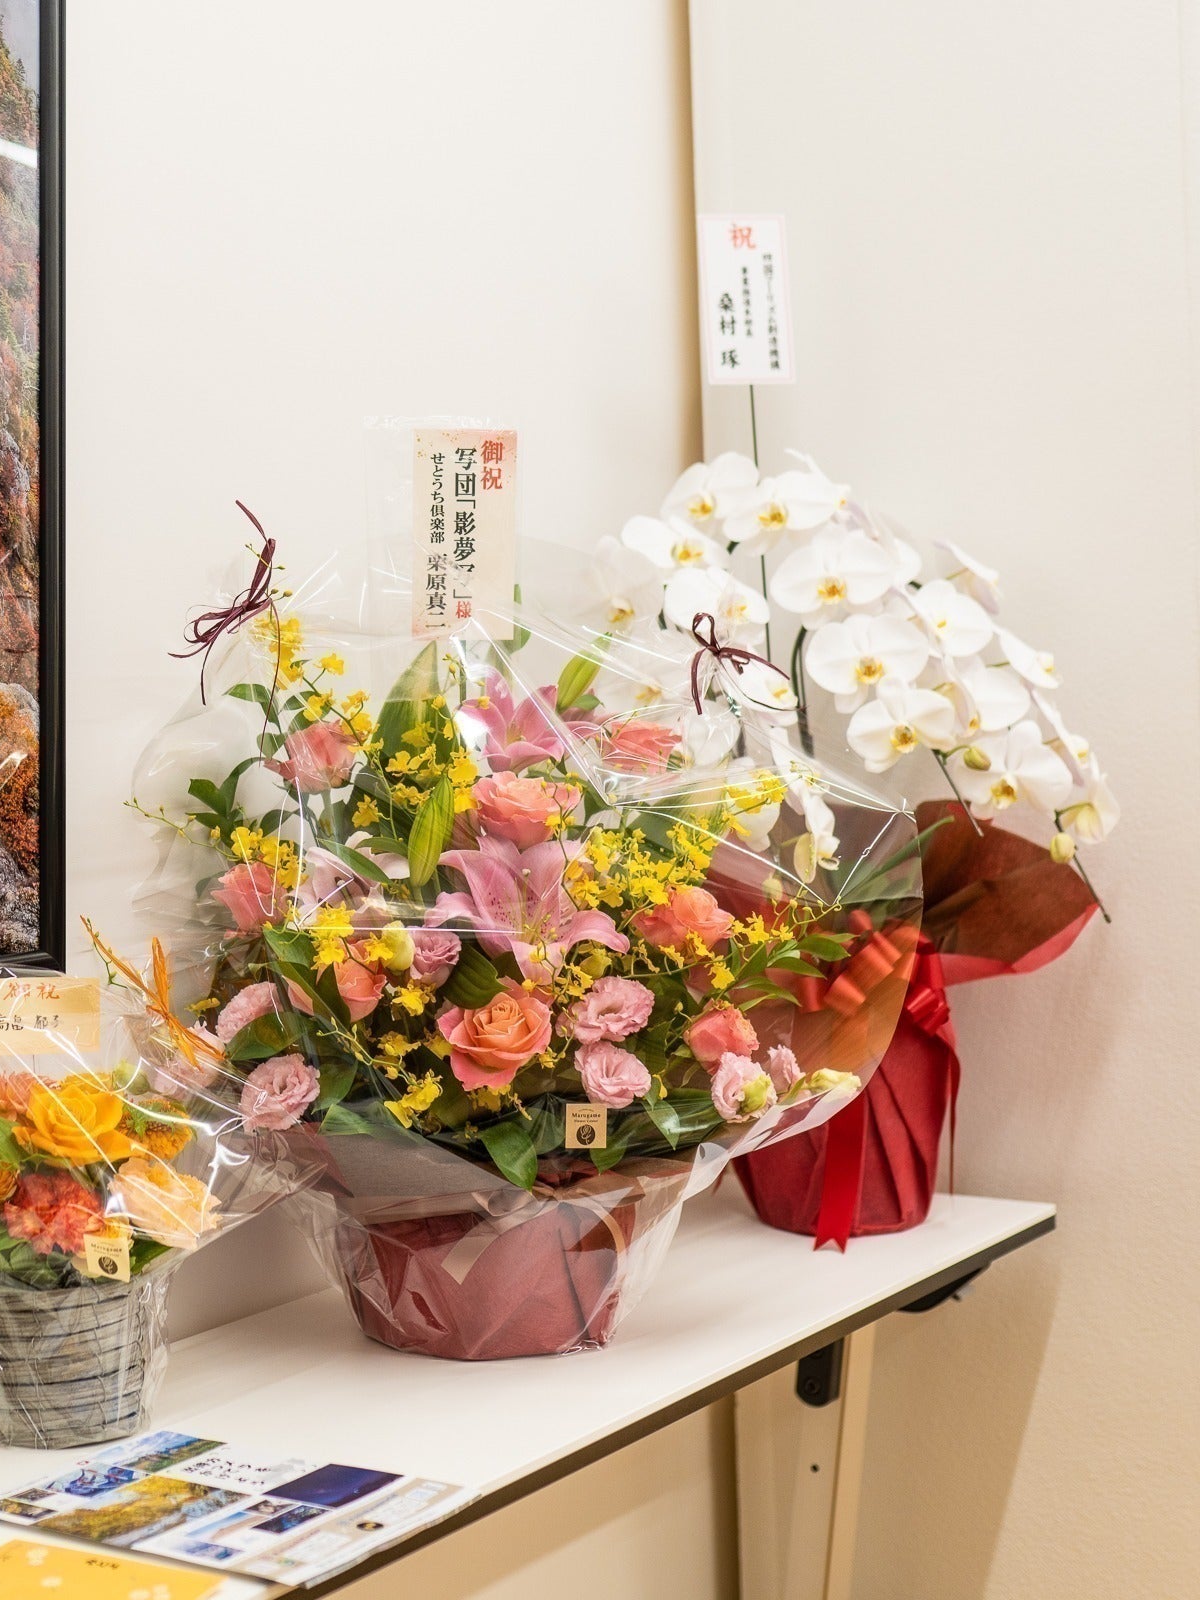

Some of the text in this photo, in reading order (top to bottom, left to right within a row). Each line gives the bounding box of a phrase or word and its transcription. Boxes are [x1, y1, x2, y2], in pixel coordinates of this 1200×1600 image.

[730, 222, 757, 250] 祝
[718, 292, 737, 336] 桑村
[480, 440, 503, 490] 御祝
[429, 452, 446, 544] せとうち倶楽部
